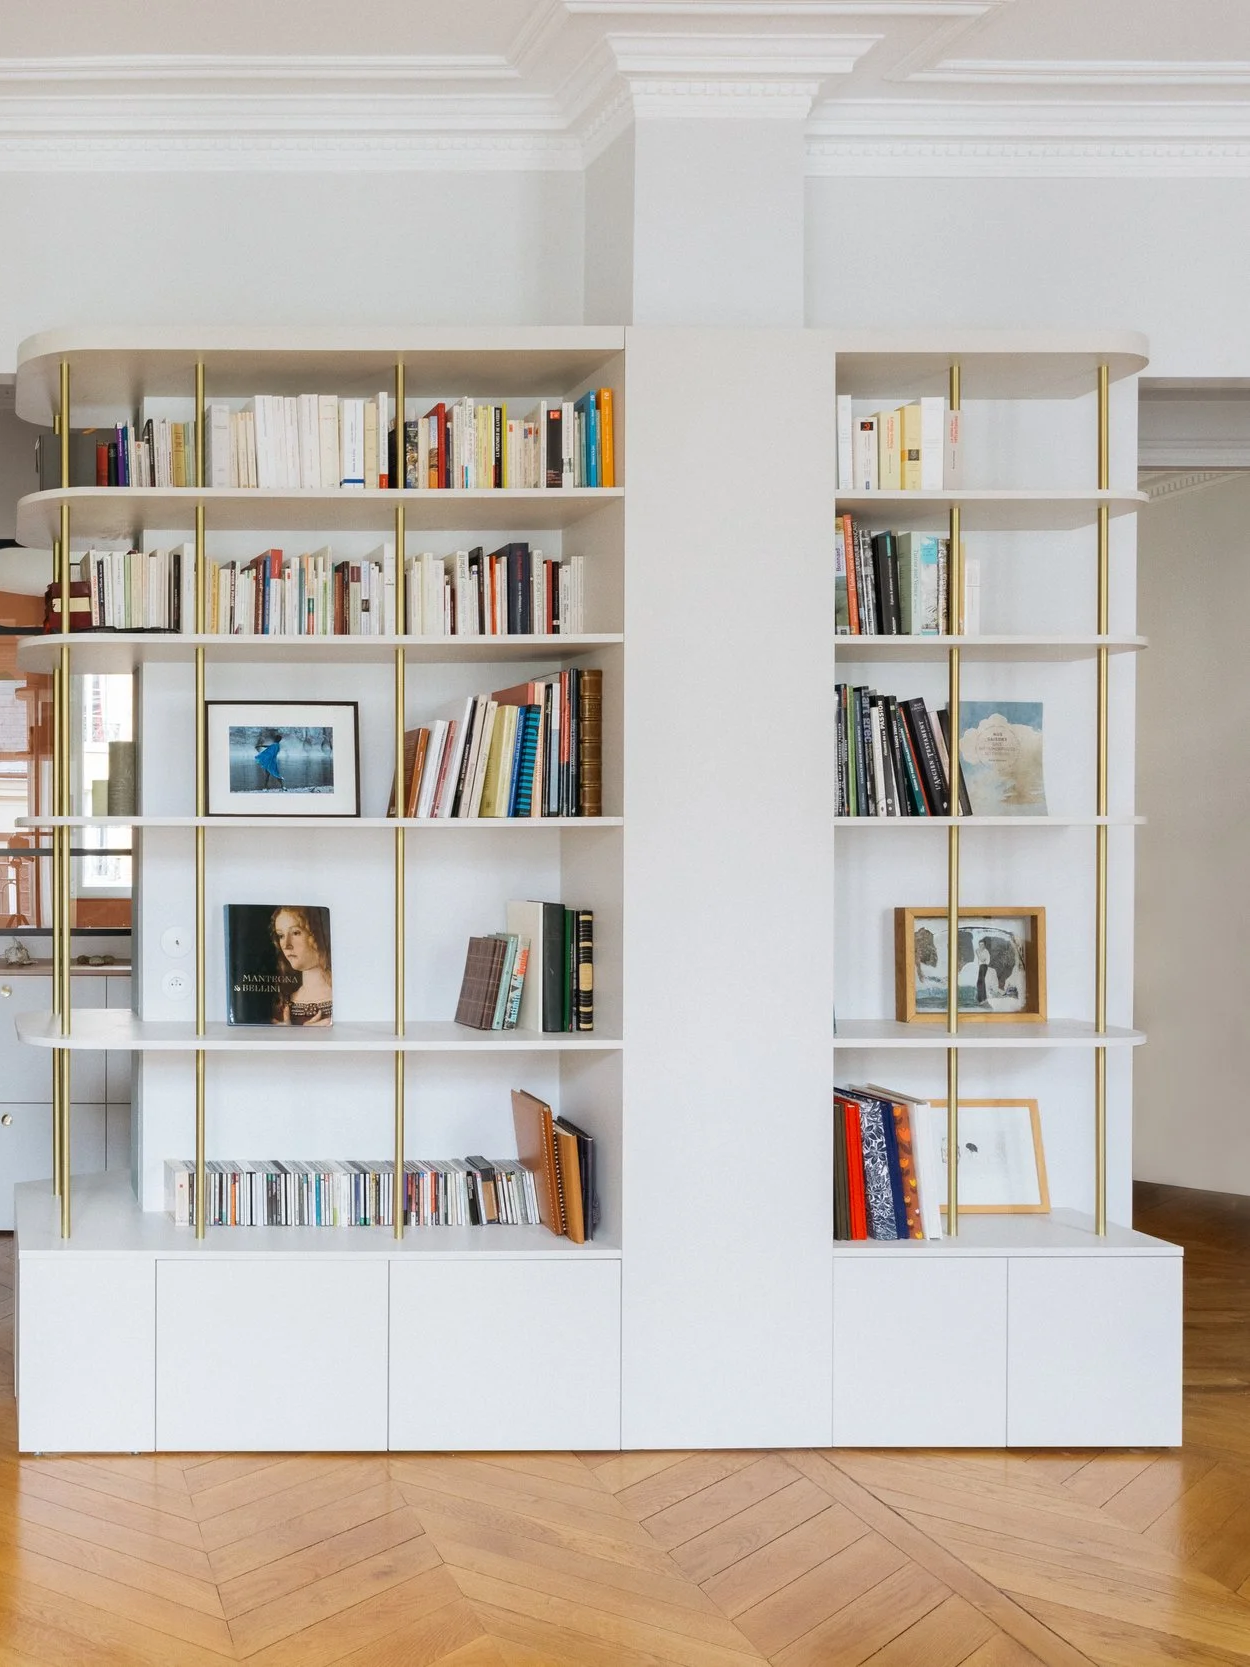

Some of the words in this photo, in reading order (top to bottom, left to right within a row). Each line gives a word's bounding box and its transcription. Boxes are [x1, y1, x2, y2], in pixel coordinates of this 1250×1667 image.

[863, 717, 873, 743] grec
[918, 720, 934, 758] TESTAMENT
[929, 760, 942, 791] L'ANCIEN
[242, 974, 298, 984] MANTEGNA
[242, 985, 281, 993] BELLINI
